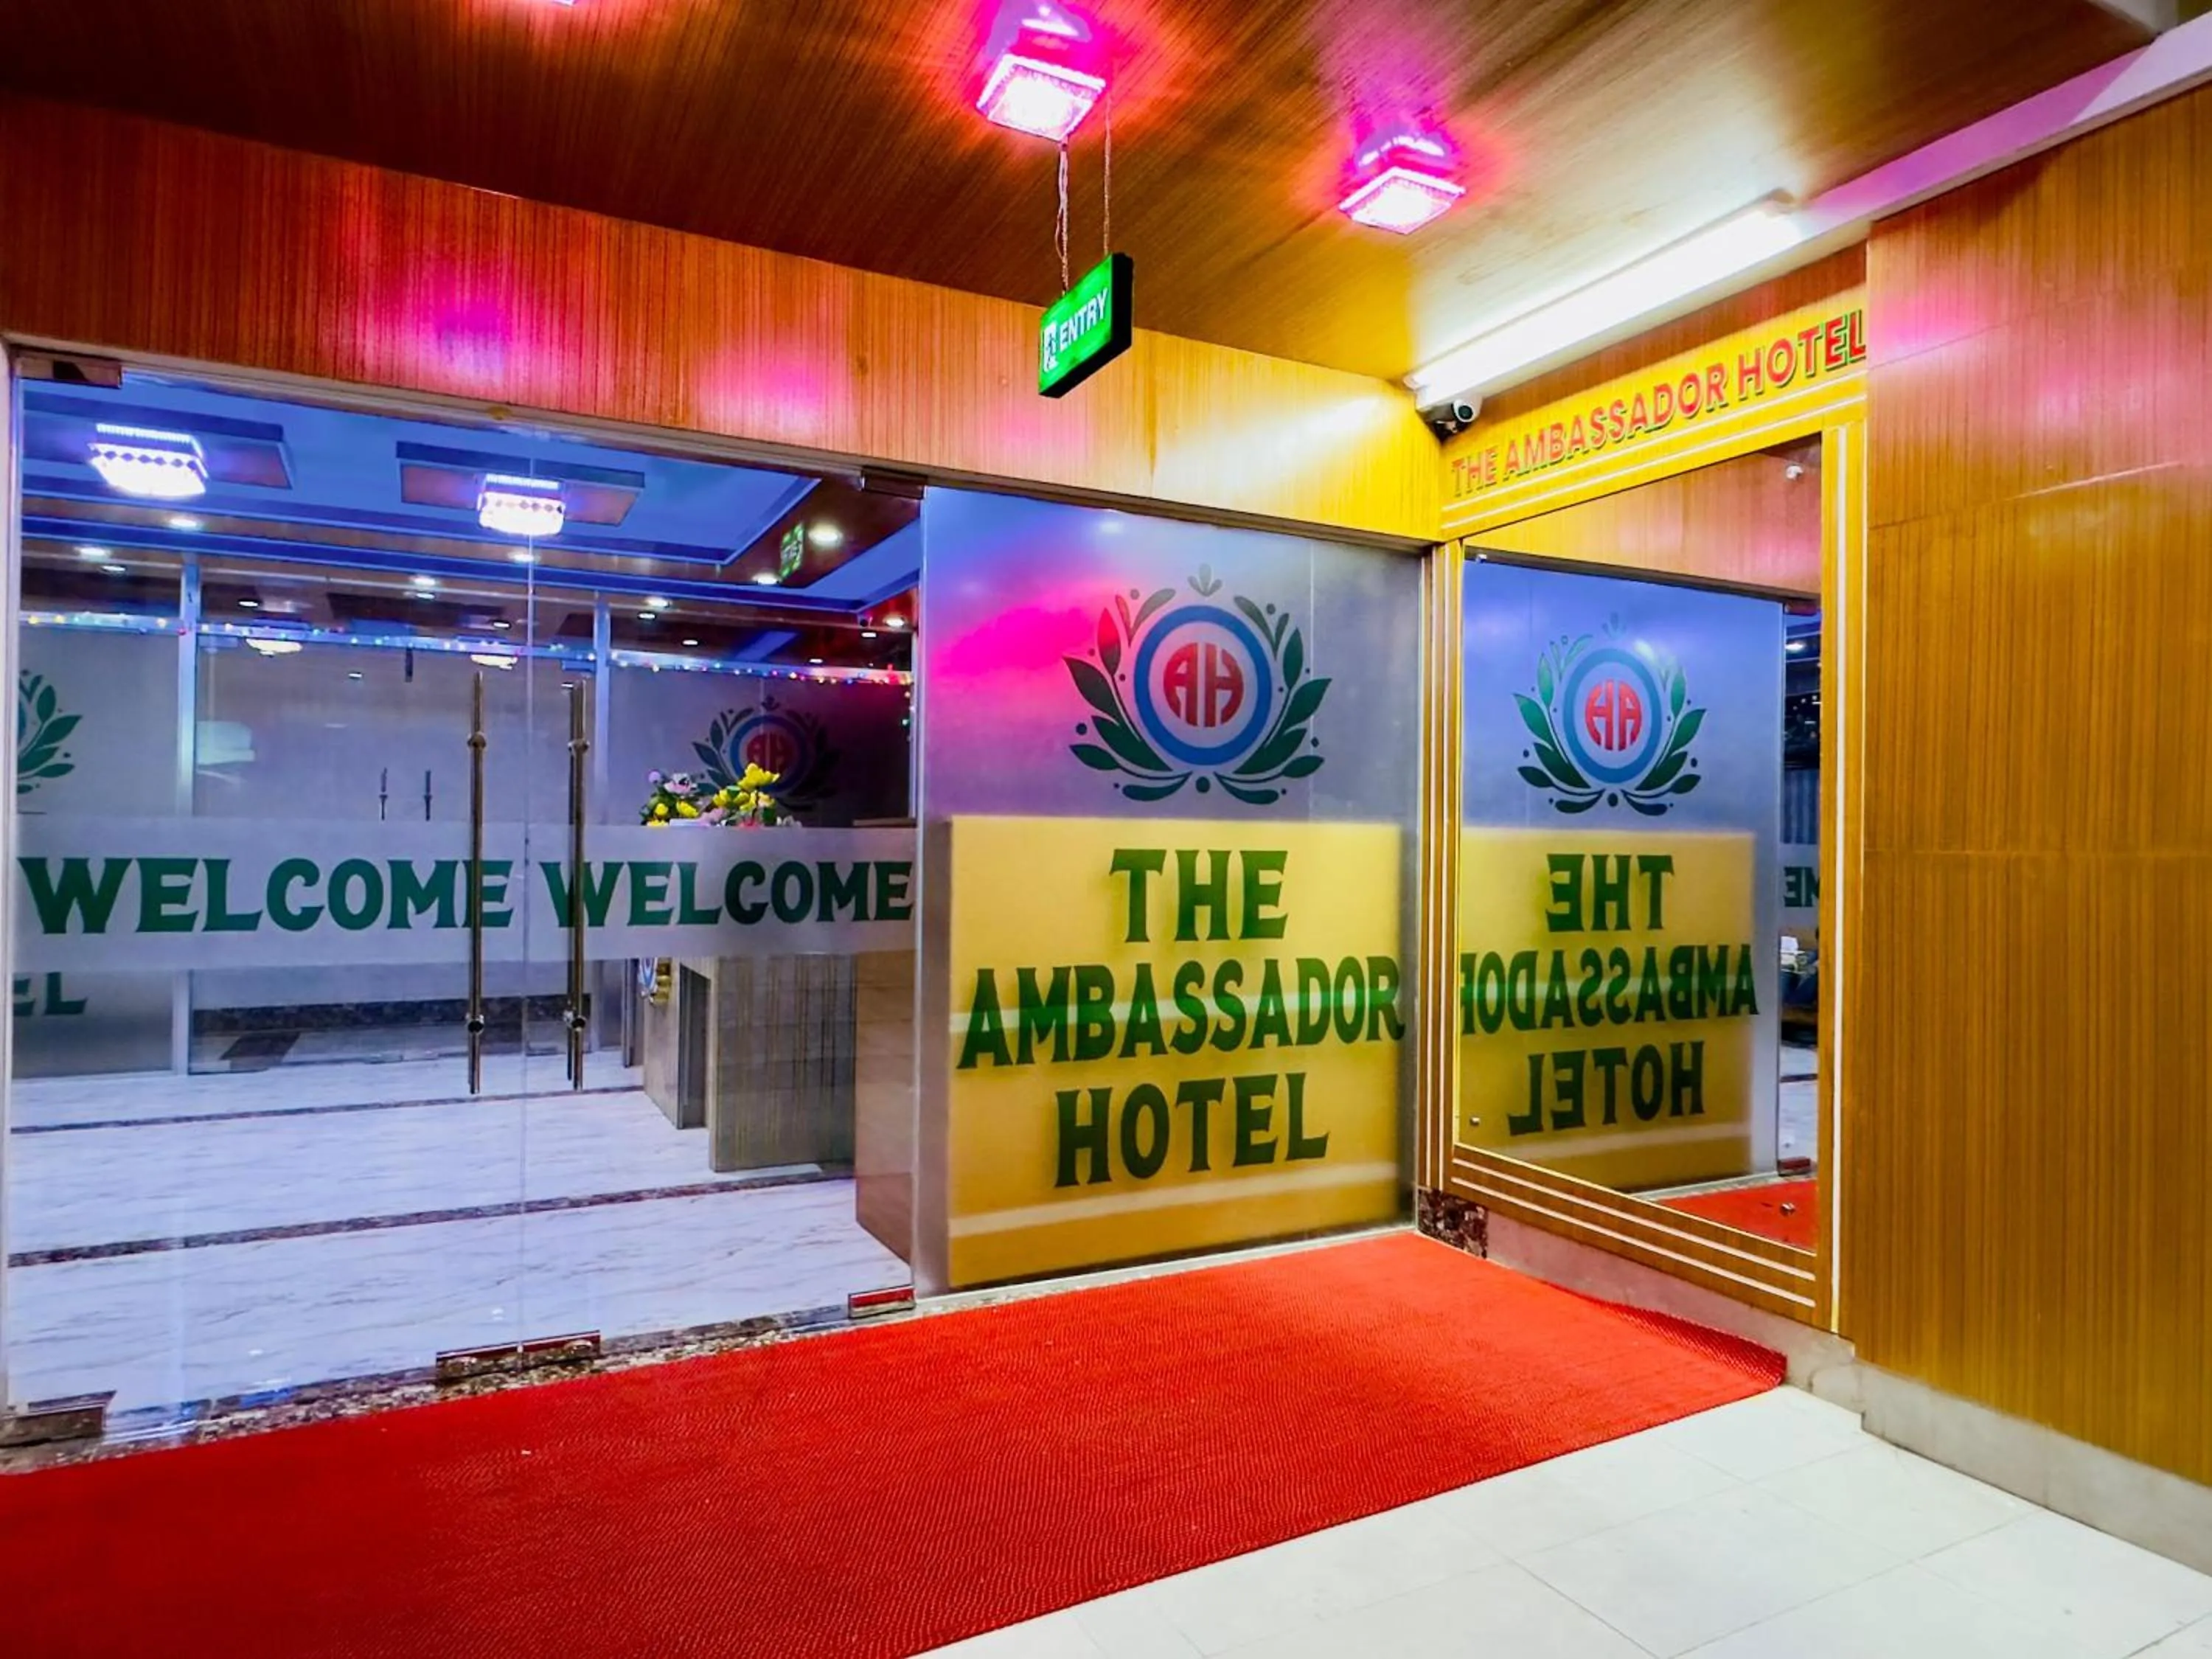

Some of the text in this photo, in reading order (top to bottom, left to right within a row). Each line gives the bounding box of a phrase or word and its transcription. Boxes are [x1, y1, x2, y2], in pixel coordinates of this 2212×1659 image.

[1059, 287, 1110, 352] ENTRY
[1452, 309, 1867, 497] THE AMBASSADOR HOTEL
[17, 857, 515, 934] WELCOME
[538, 860, 914, 928] WELCOME
[1109, 848, 1289, 943] THE
[956, 955, 1405, 1070] AMBASSADOR
[1054, 1071, 1330, 1189] HOTEL
